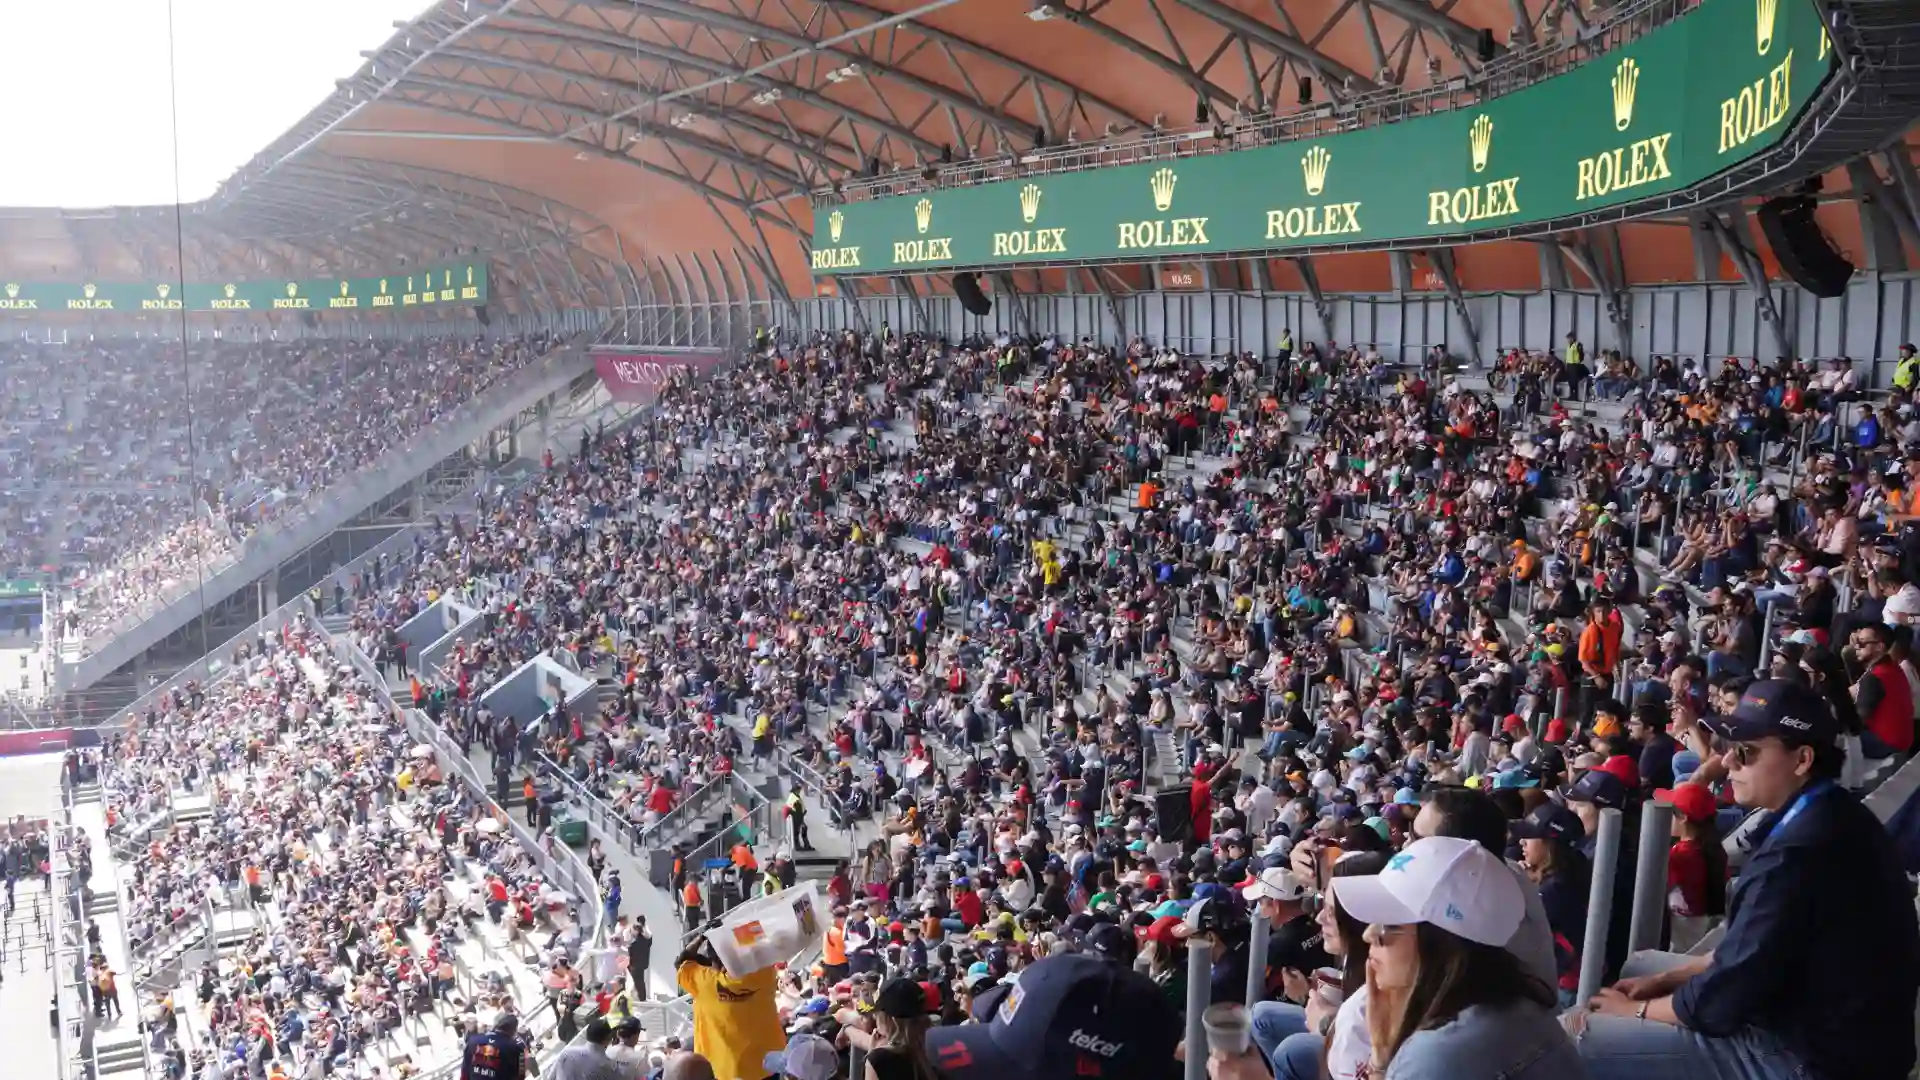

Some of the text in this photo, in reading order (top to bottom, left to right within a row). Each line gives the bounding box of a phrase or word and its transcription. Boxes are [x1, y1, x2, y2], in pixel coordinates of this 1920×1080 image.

[1577, 132, 1672, 200] ROLEX
[1427, 177, 1520, 225] ROLEX
[1265, 202, 1362, 239] ROLEX
[993, 228, 1067, 256] ROLEX
[1118, 218, 1209, 249] ROLEX
[812, 246, 861, 269] ROLEX
[893, 238, 952, 264] ROLEX
[0, 299, 38, 309] OLEX
[67, 299, 114, 310] ROLEX
[142, 299, 185, 309] ROLEX
[211, 299, 251, 309] ROLEX
[273, 298, 309, 309] ROLEX
[612, 360, 667, 385] MEXICO
[1780, 716, 1812, 730] telcel
[1068, 1028, 1124, 1057] telcel
